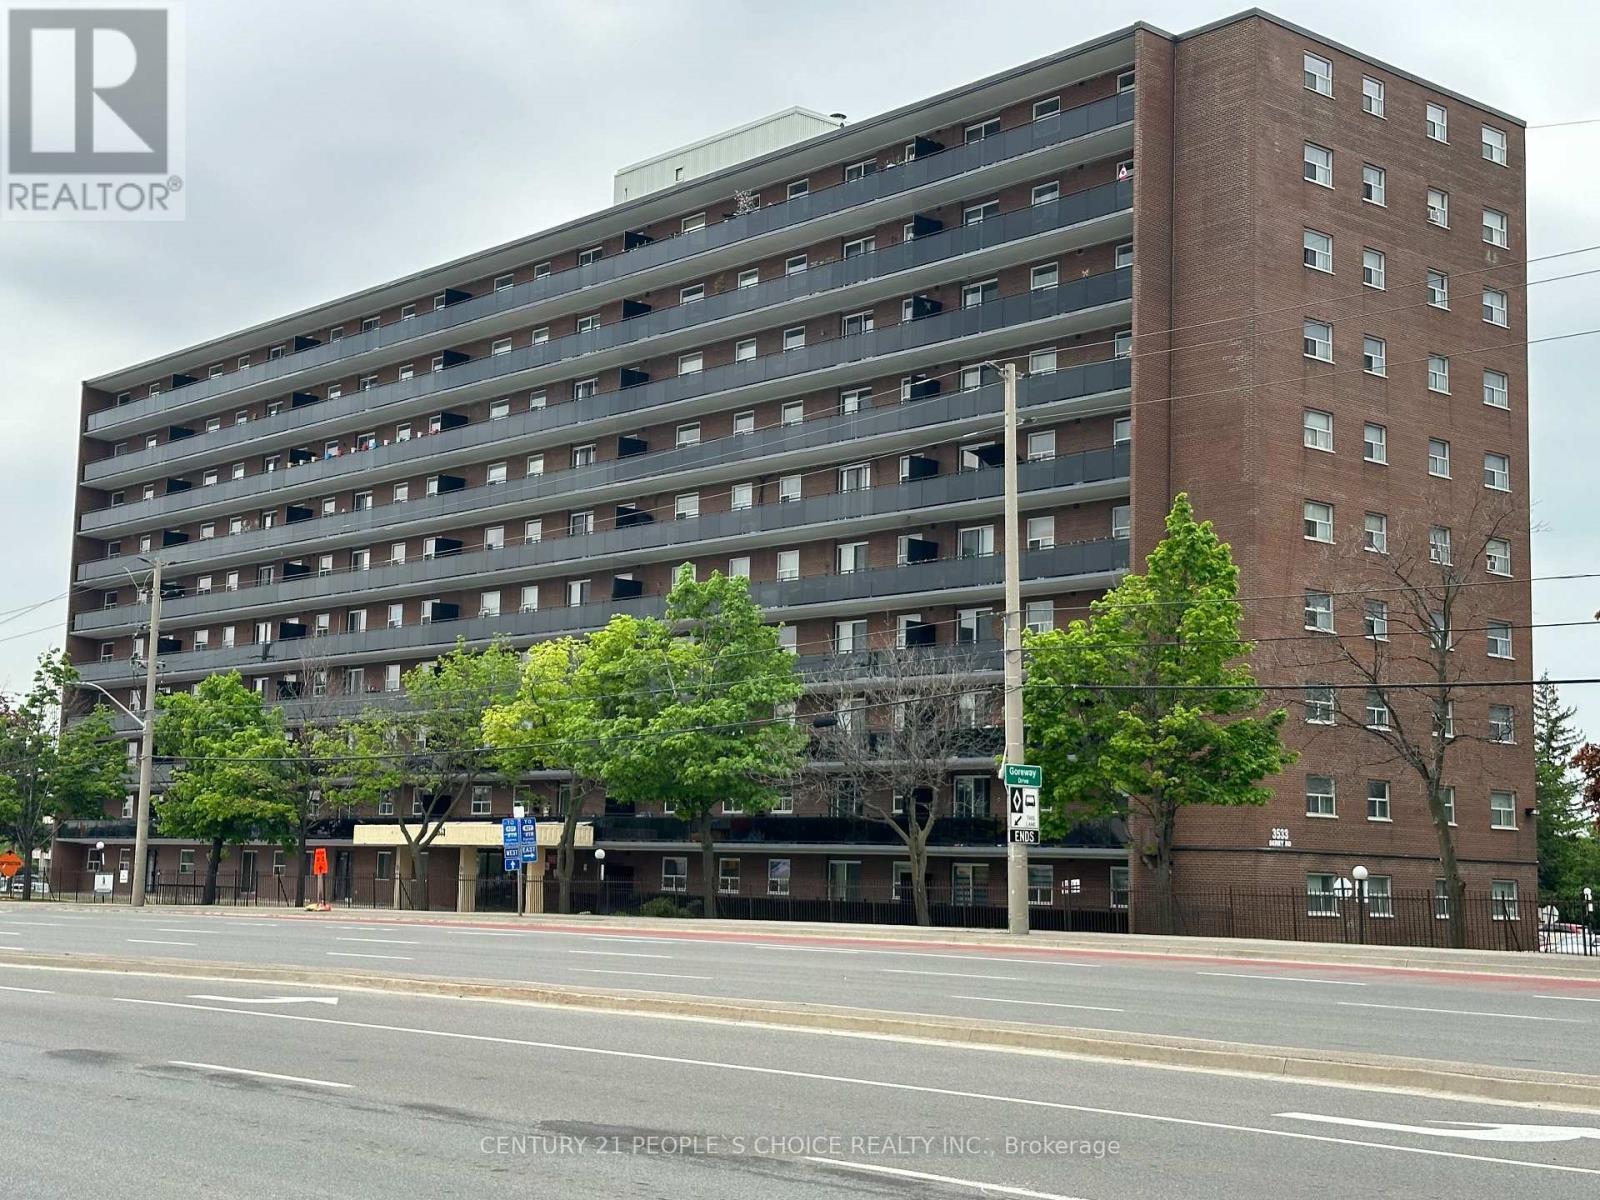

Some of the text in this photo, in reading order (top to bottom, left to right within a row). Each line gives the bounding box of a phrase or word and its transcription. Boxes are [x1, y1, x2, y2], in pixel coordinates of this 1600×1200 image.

[1009, 767, 1037, 777] Goreway
[1014, 831, 1034, 842] ENDS
[1272, 828, 1288, 840] 3533
